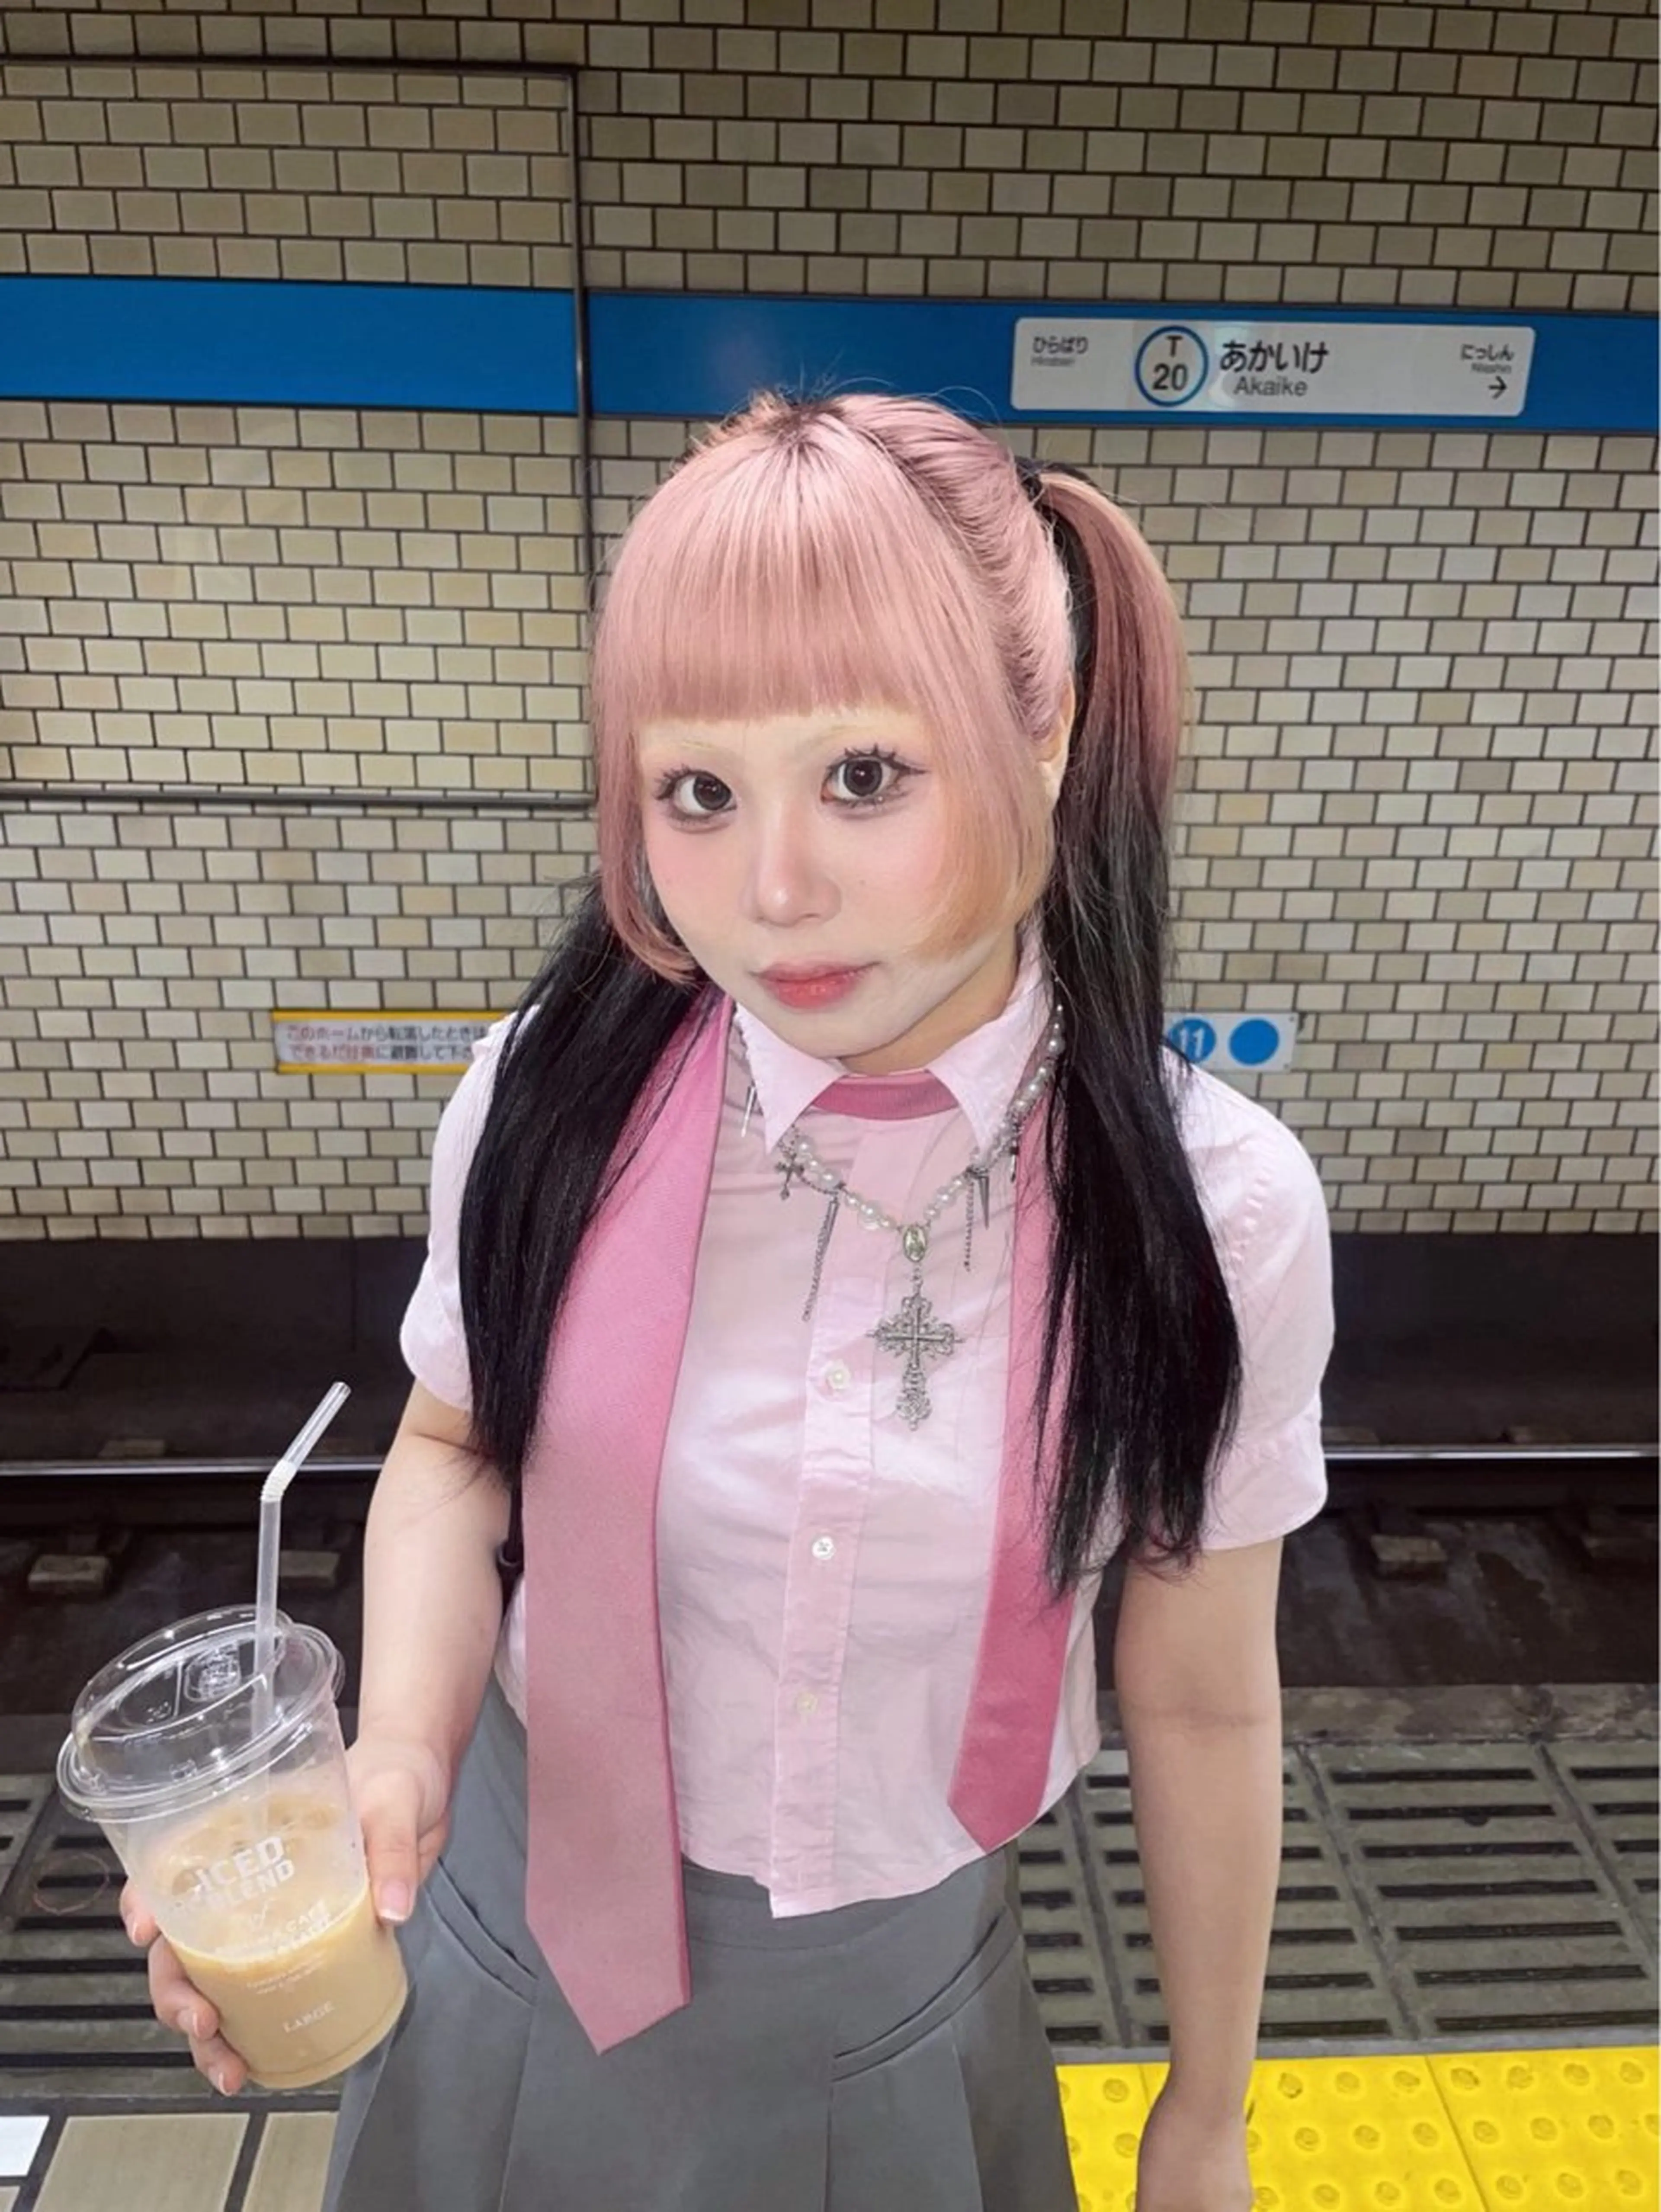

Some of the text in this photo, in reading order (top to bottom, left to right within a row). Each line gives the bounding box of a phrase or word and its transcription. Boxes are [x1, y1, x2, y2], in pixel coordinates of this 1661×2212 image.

[1033, 335, 1089, 354] ひらばり
[1167, 335, 1183, 357] T
[1219, 340, 1329, 374] あかいけ
[1460, 343, 1515, 362] にっしん
[1152, 363, 1188, 390] 20
[1234, 376, 1308, 397] Akaike
[1179, 1026, 1206, 1057] 11
[195, 1836, 284, 1889] ICED
[282, 2000, 336, 2033] LARGE
